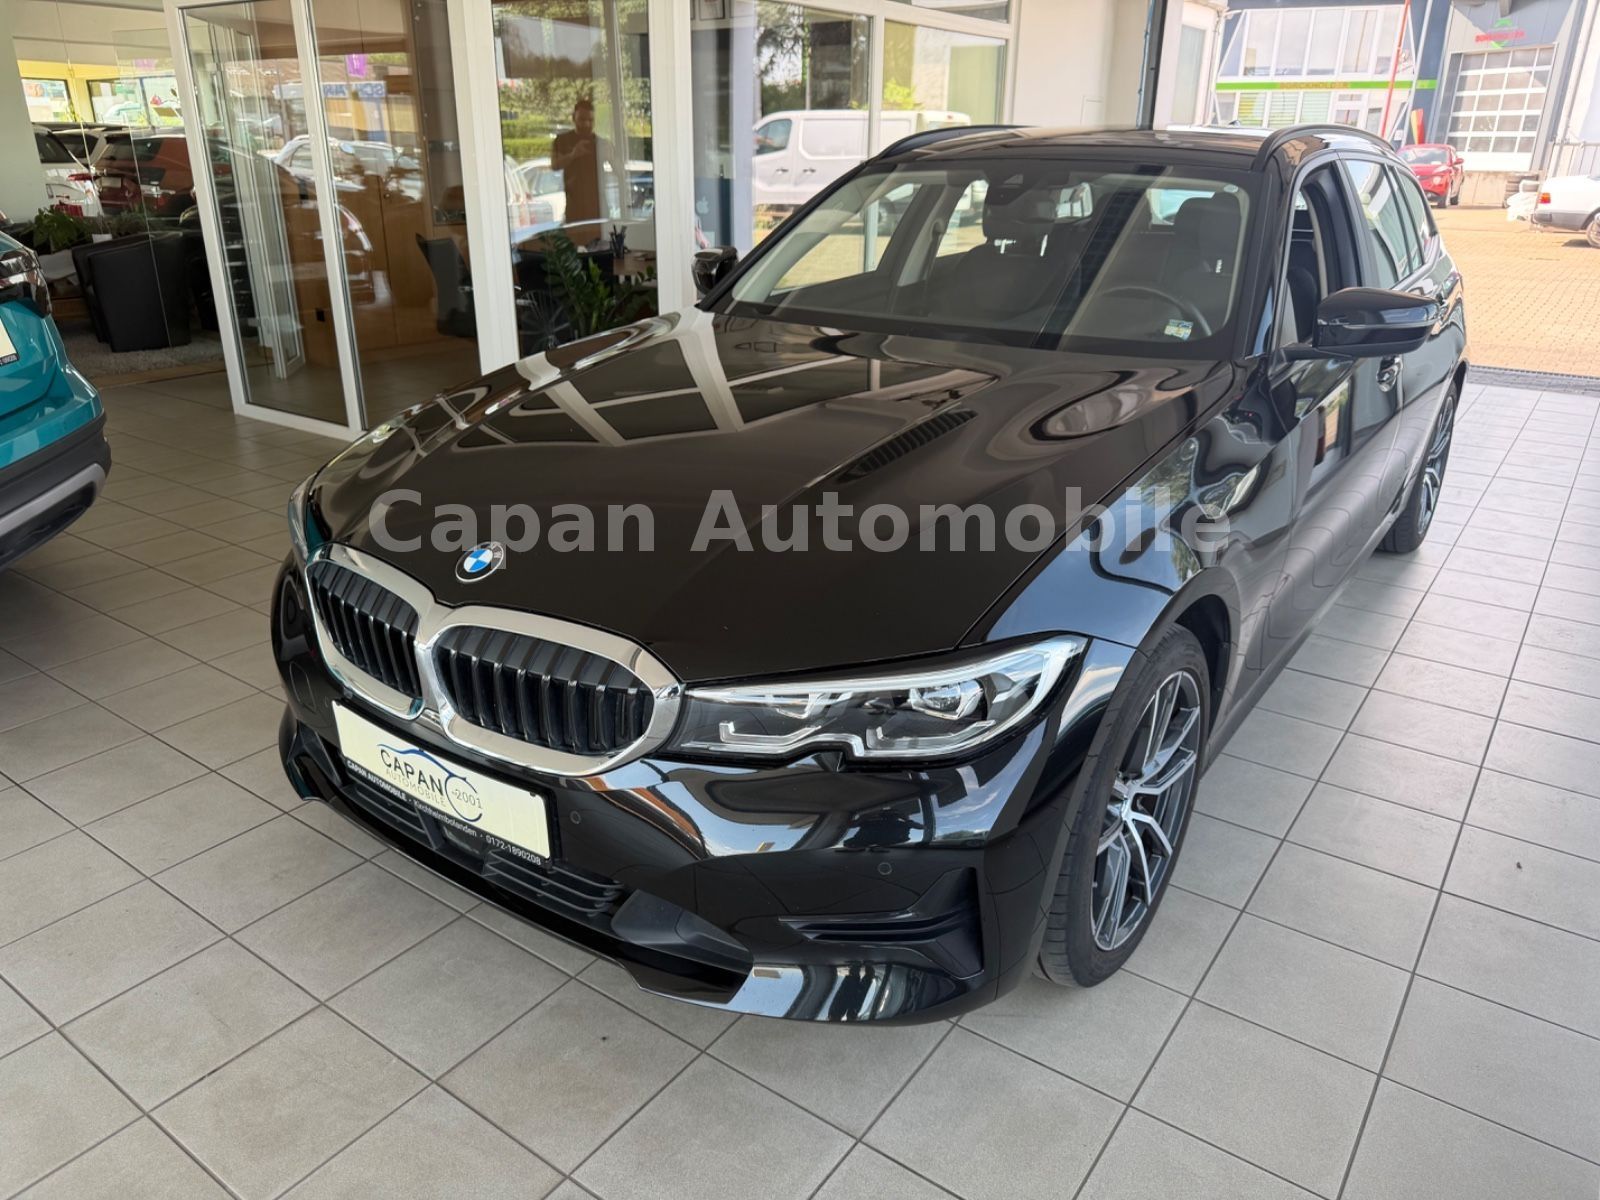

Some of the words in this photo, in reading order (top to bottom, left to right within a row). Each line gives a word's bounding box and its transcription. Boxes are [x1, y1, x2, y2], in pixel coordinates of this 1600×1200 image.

[367, 771, 407, 802] AUTOMOBILE
[380, 749, 444, 797] CAPAN
[386, 768, 448, 807] AUTOMOBILE
